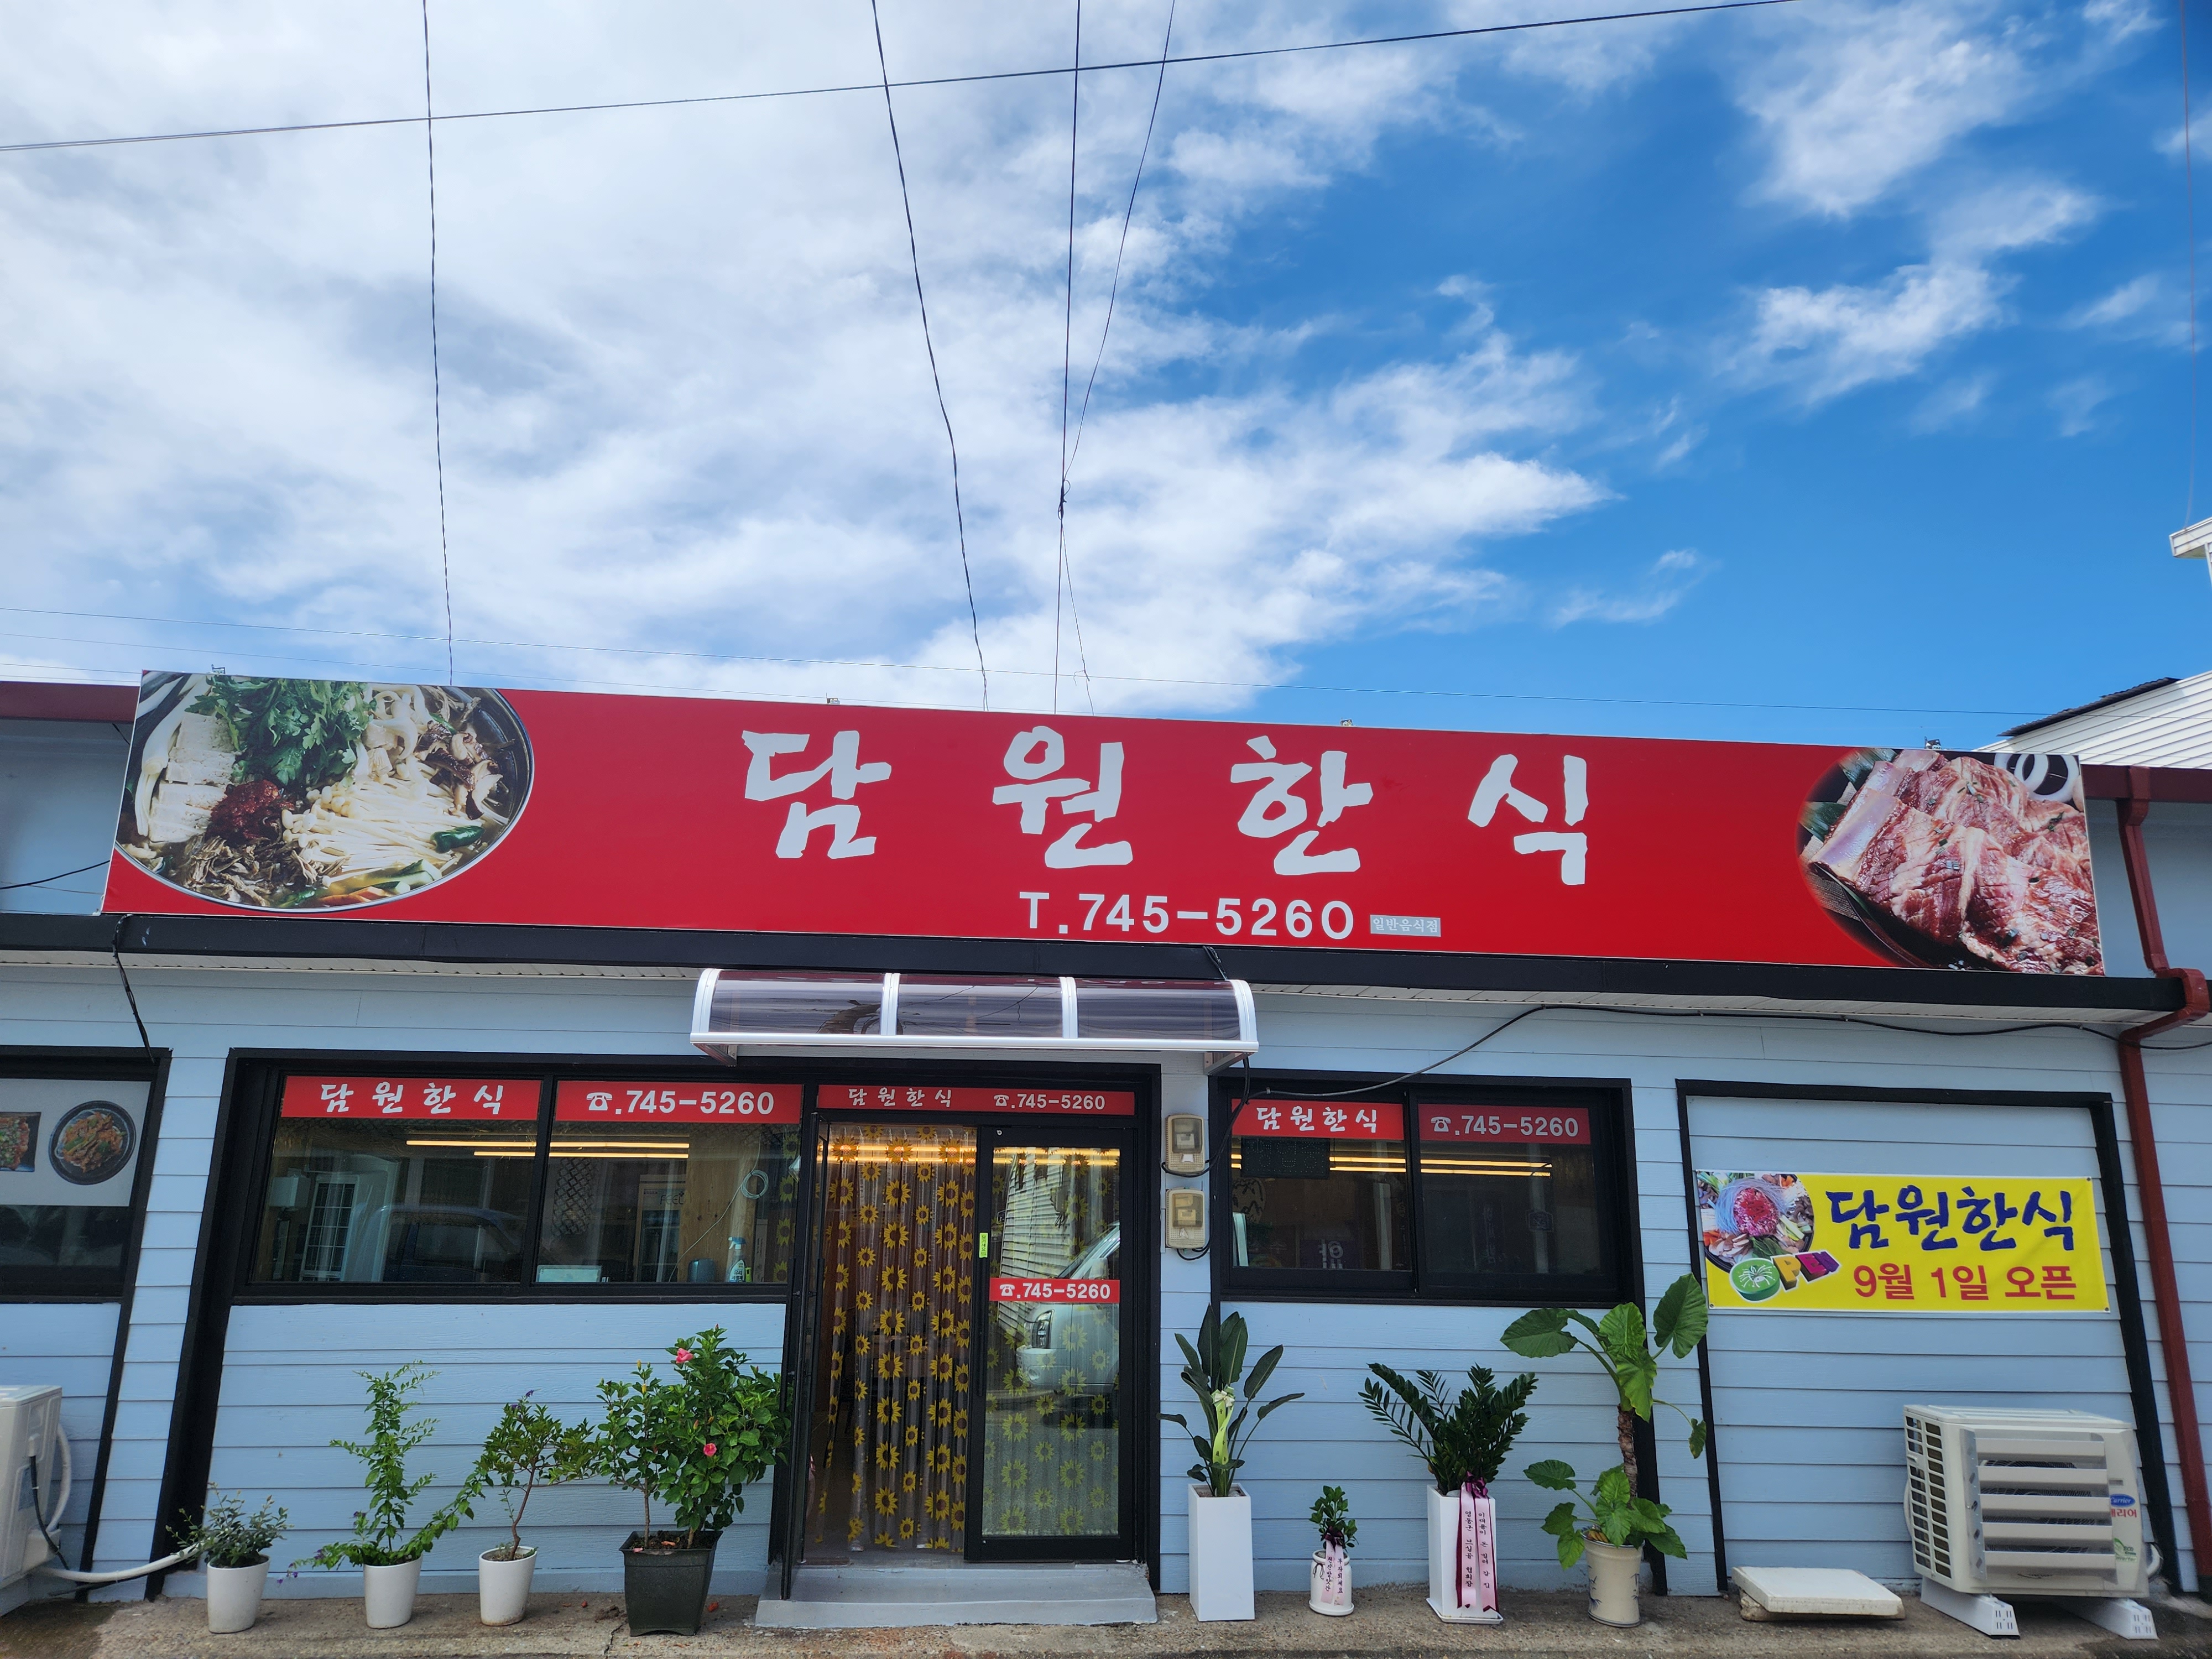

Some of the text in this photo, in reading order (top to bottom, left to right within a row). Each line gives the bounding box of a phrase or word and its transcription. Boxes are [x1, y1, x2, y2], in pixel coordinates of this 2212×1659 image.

[1373, 917, 1438, 933] 일반음식점
[1825, 1185, 2074, 1251] 담원한식
[1854, 1263, 2077, 1301] 9월 1일 오픈
